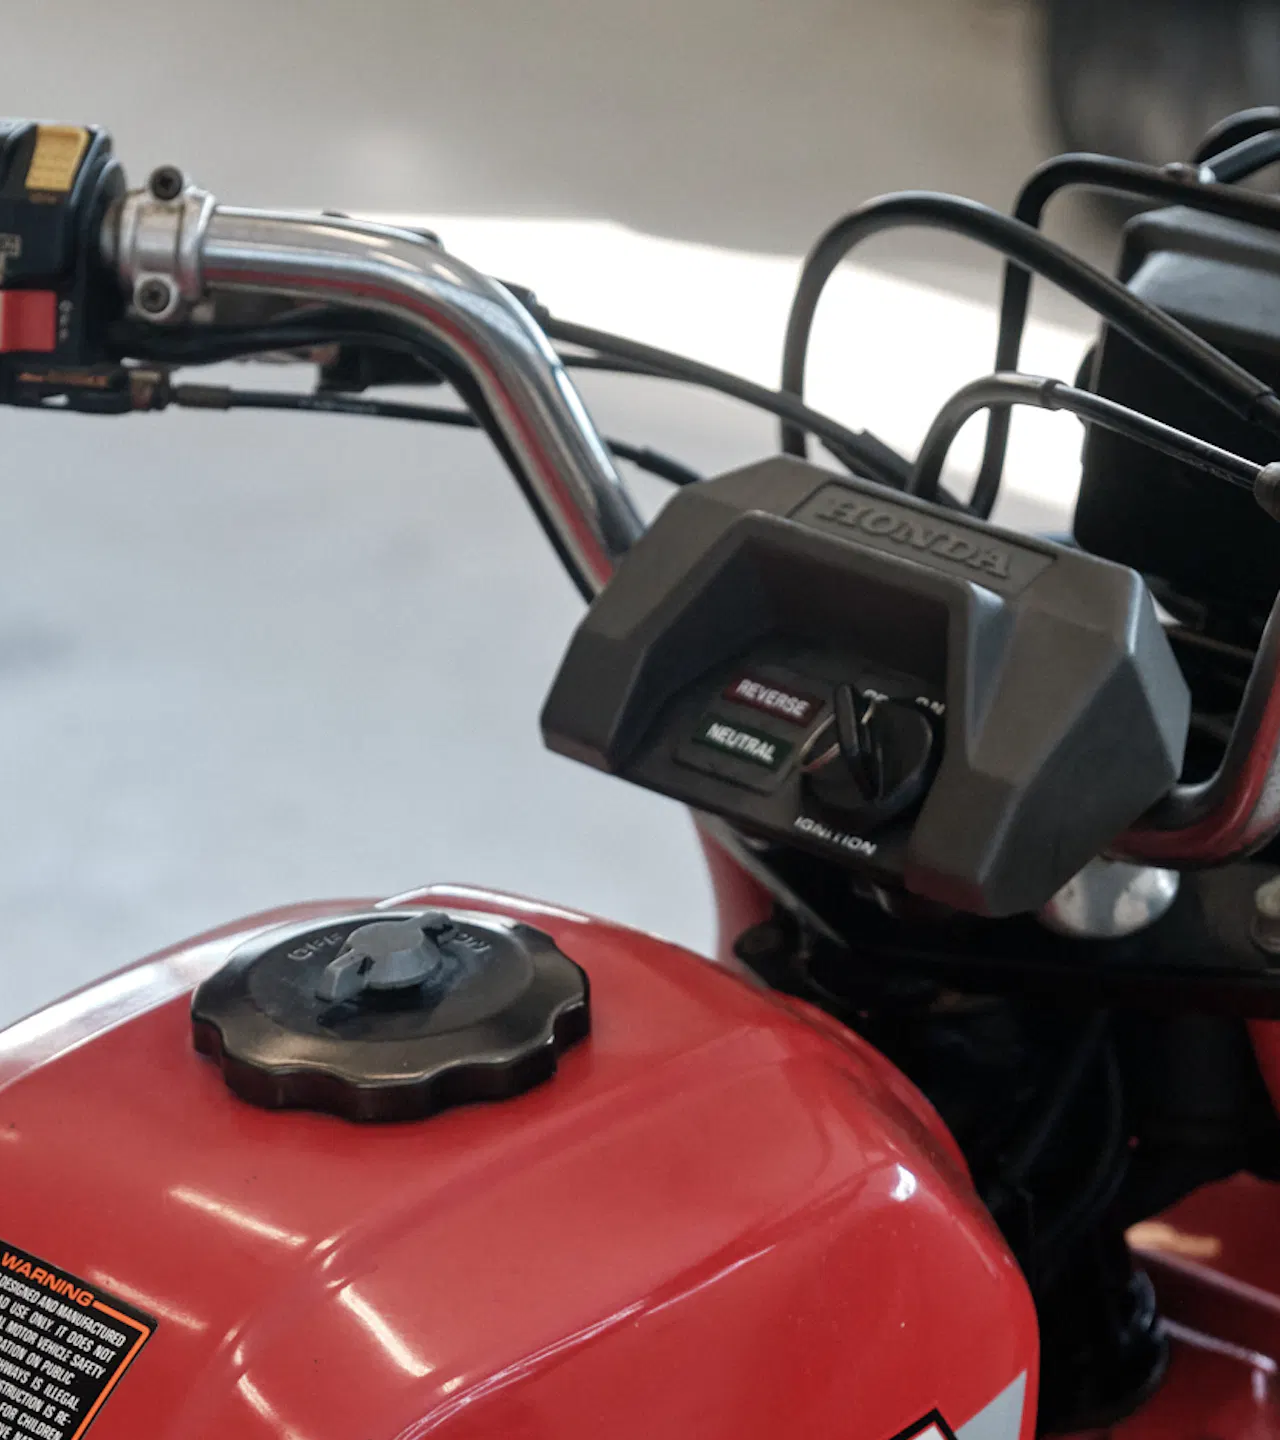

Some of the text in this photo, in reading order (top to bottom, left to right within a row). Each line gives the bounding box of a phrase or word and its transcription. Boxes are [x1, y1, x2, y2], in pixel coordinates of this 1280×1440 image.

[815, 500, 1011, 580] HONDA
[735, 679, 811, 718] REVERSE
[705, 722, 776, 764] NEUTRAL
[793, 815, 877, 855] IGNITION
[0, 1252, 95, 1307] WARNING
[8, 1301, 30, 1320] USE
[53, 1324, 68, 1339] IT
[65, 1330, 94, 1352] DOES
[92, 1344, 116, 1364] NOT
[36, 1294, 60, 1314] AND
[54, 1303, 127, 1348] MANUFACTURED
[4, 1320, 39, 1346] MOTOR
[35, 1335, 73, 1362] VEHICLE
[68, 1352, 106, 1379] SAFETY
[24, 1352, 44, 1368] ON
[39, 1359, 76, 1386] PUBLIC
[29, 1375, 44, 1392] IS
[41, 1403, 57, 1419] IS
